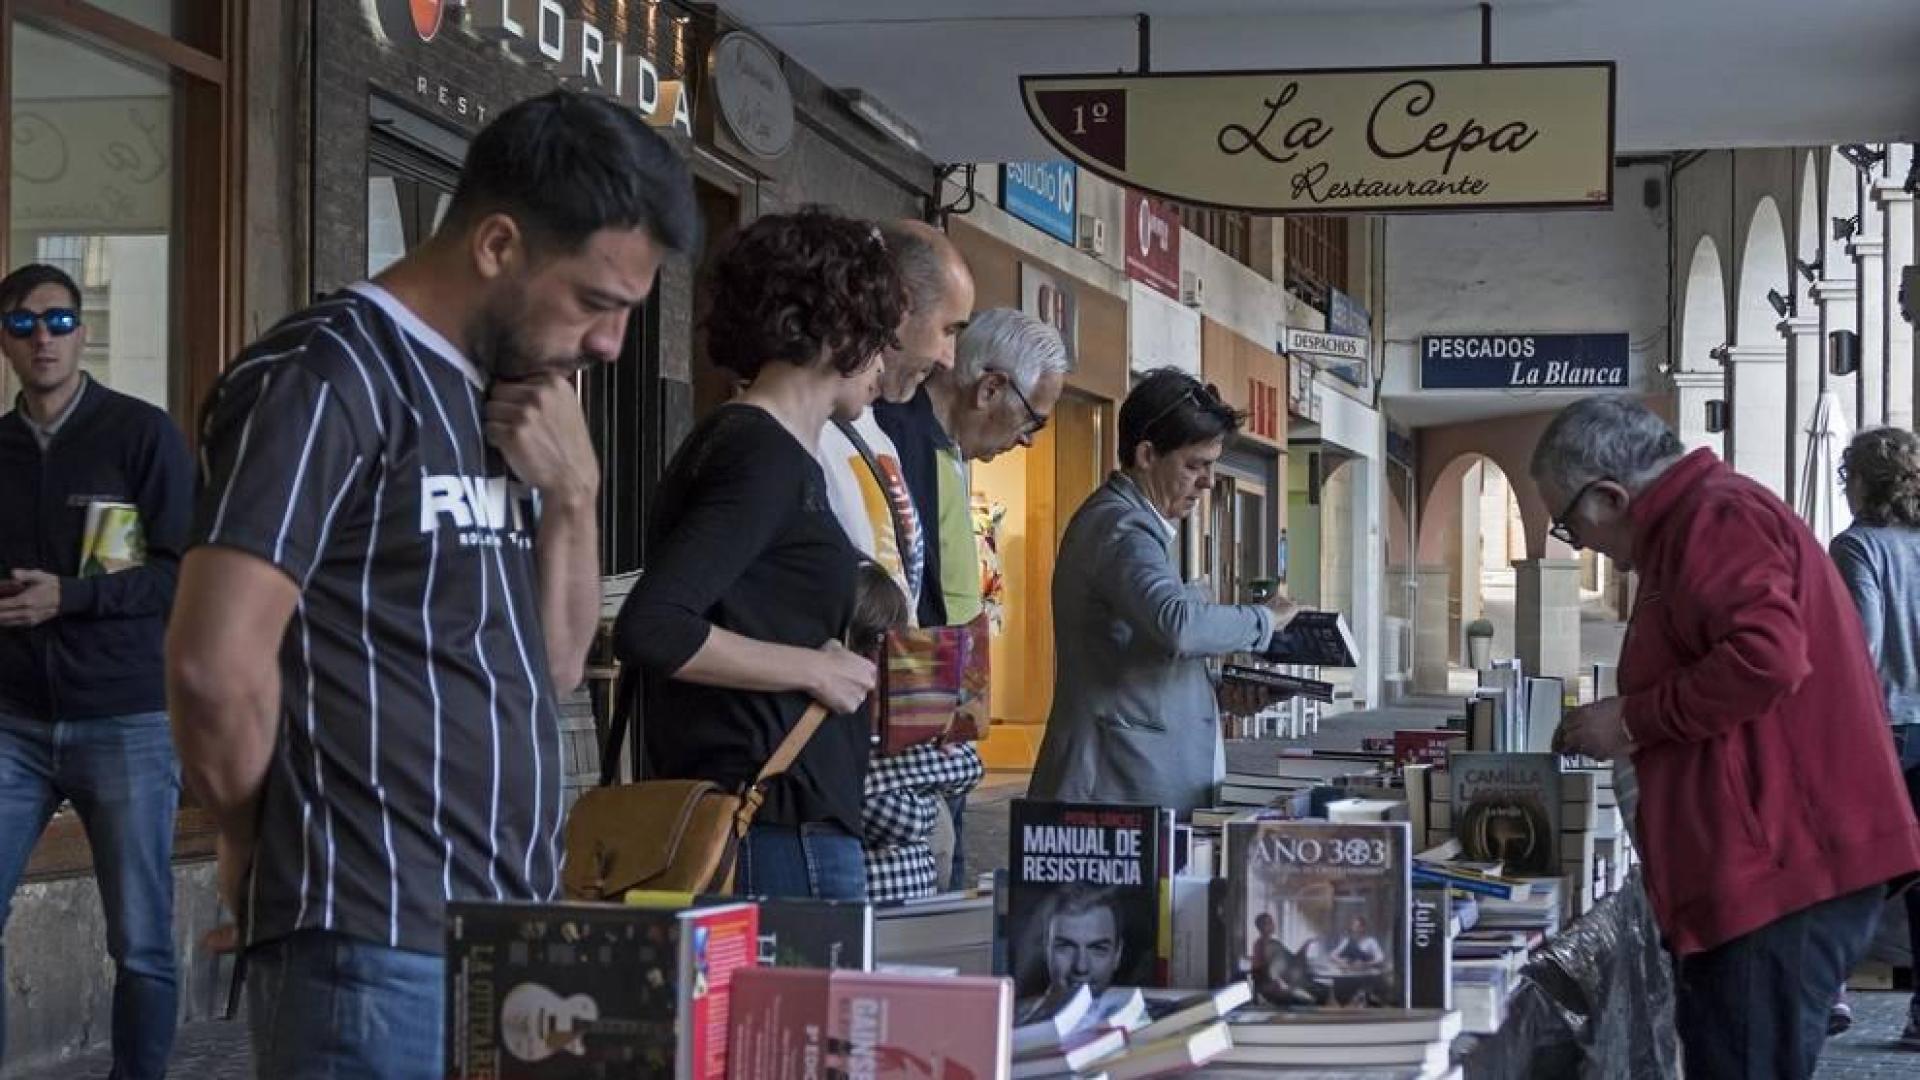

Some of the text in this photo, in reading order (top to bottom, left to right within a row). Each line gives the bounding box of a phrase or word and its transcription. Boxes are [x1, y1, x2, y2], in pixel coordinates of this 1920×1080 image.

[456, 0, 693, 138] LORIDA
[416, 75, 487, 122] REST
[1071, 102, 1108, 135] 1º
[1217, 79, 1539, 175] La Cepa
[1290, 161, 1490, 204] Restaurante
[1294, 333, 1357, 354] DESPACHOS
[1428, 337, 1535, 358] PESCADOS
[1508, 360, 1623, 385] La Blanca
[1464, 768, 1544, 786] CAMILLA
[1023, 825, 1142, 857] MANUAL DE
[1252, 833, 1322, 865] AÑO
[1023, 855, 1142, 885] RESISTENCIA
[1412, 900, 1436, 948] Julio
